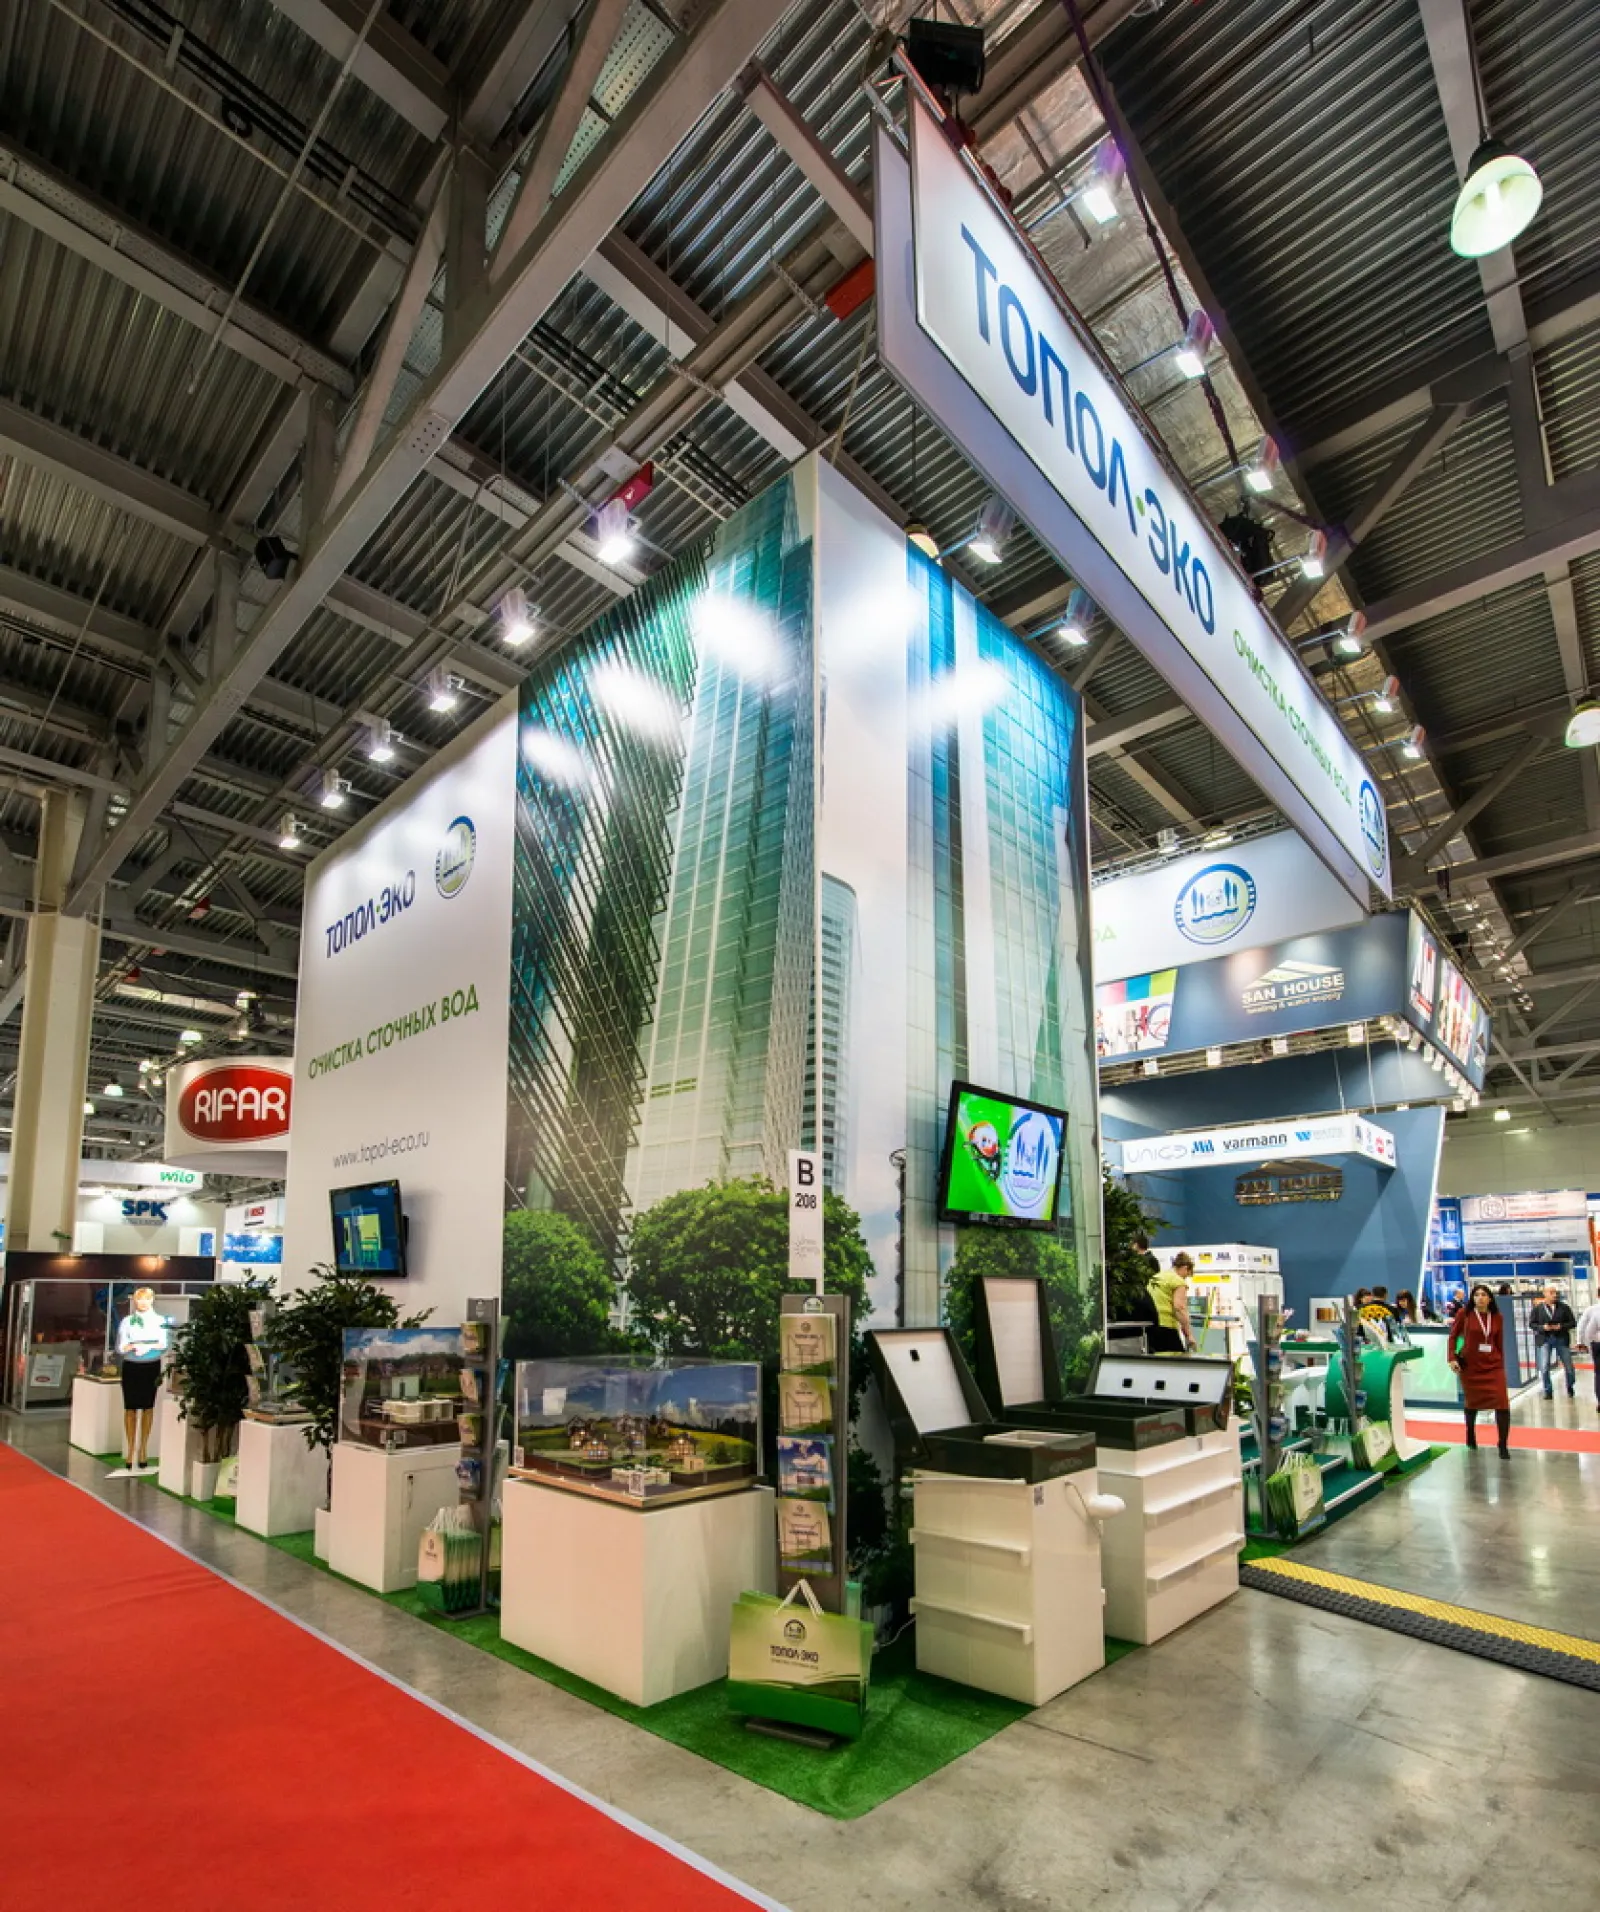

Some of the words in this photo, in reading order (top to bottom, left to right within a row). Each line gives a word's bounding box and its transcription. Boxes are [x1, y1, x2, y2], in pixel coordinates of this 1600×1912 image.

[1233, 629, 1288, 717] ОЧИСТКА
[1288, 705, 1332, 780] СТОЧНЫХ
[1242, 987, 1276, 1004] SAN
[1283, 973, 1344, 996] HOUSE
[308, 1037, 364, 1079] ОЧИСТКА
[366, 1000, 436, 1056] СТОЧНЫХ
[441, 983, 479, 1022] ВОД
[194, 1087, 286, 1124] RIFAR
[332, 1129, 430, 1168] www.topol-eco.ru
[1223, 1133, 1288, 1150] varmann
[160, 1170, 195, 1184] wilo
[1279, 1171, 1343, 1191] HOUSE
[122, 1199, 168, 1221] SPK
[795, 1192, 817, 1209] 208
